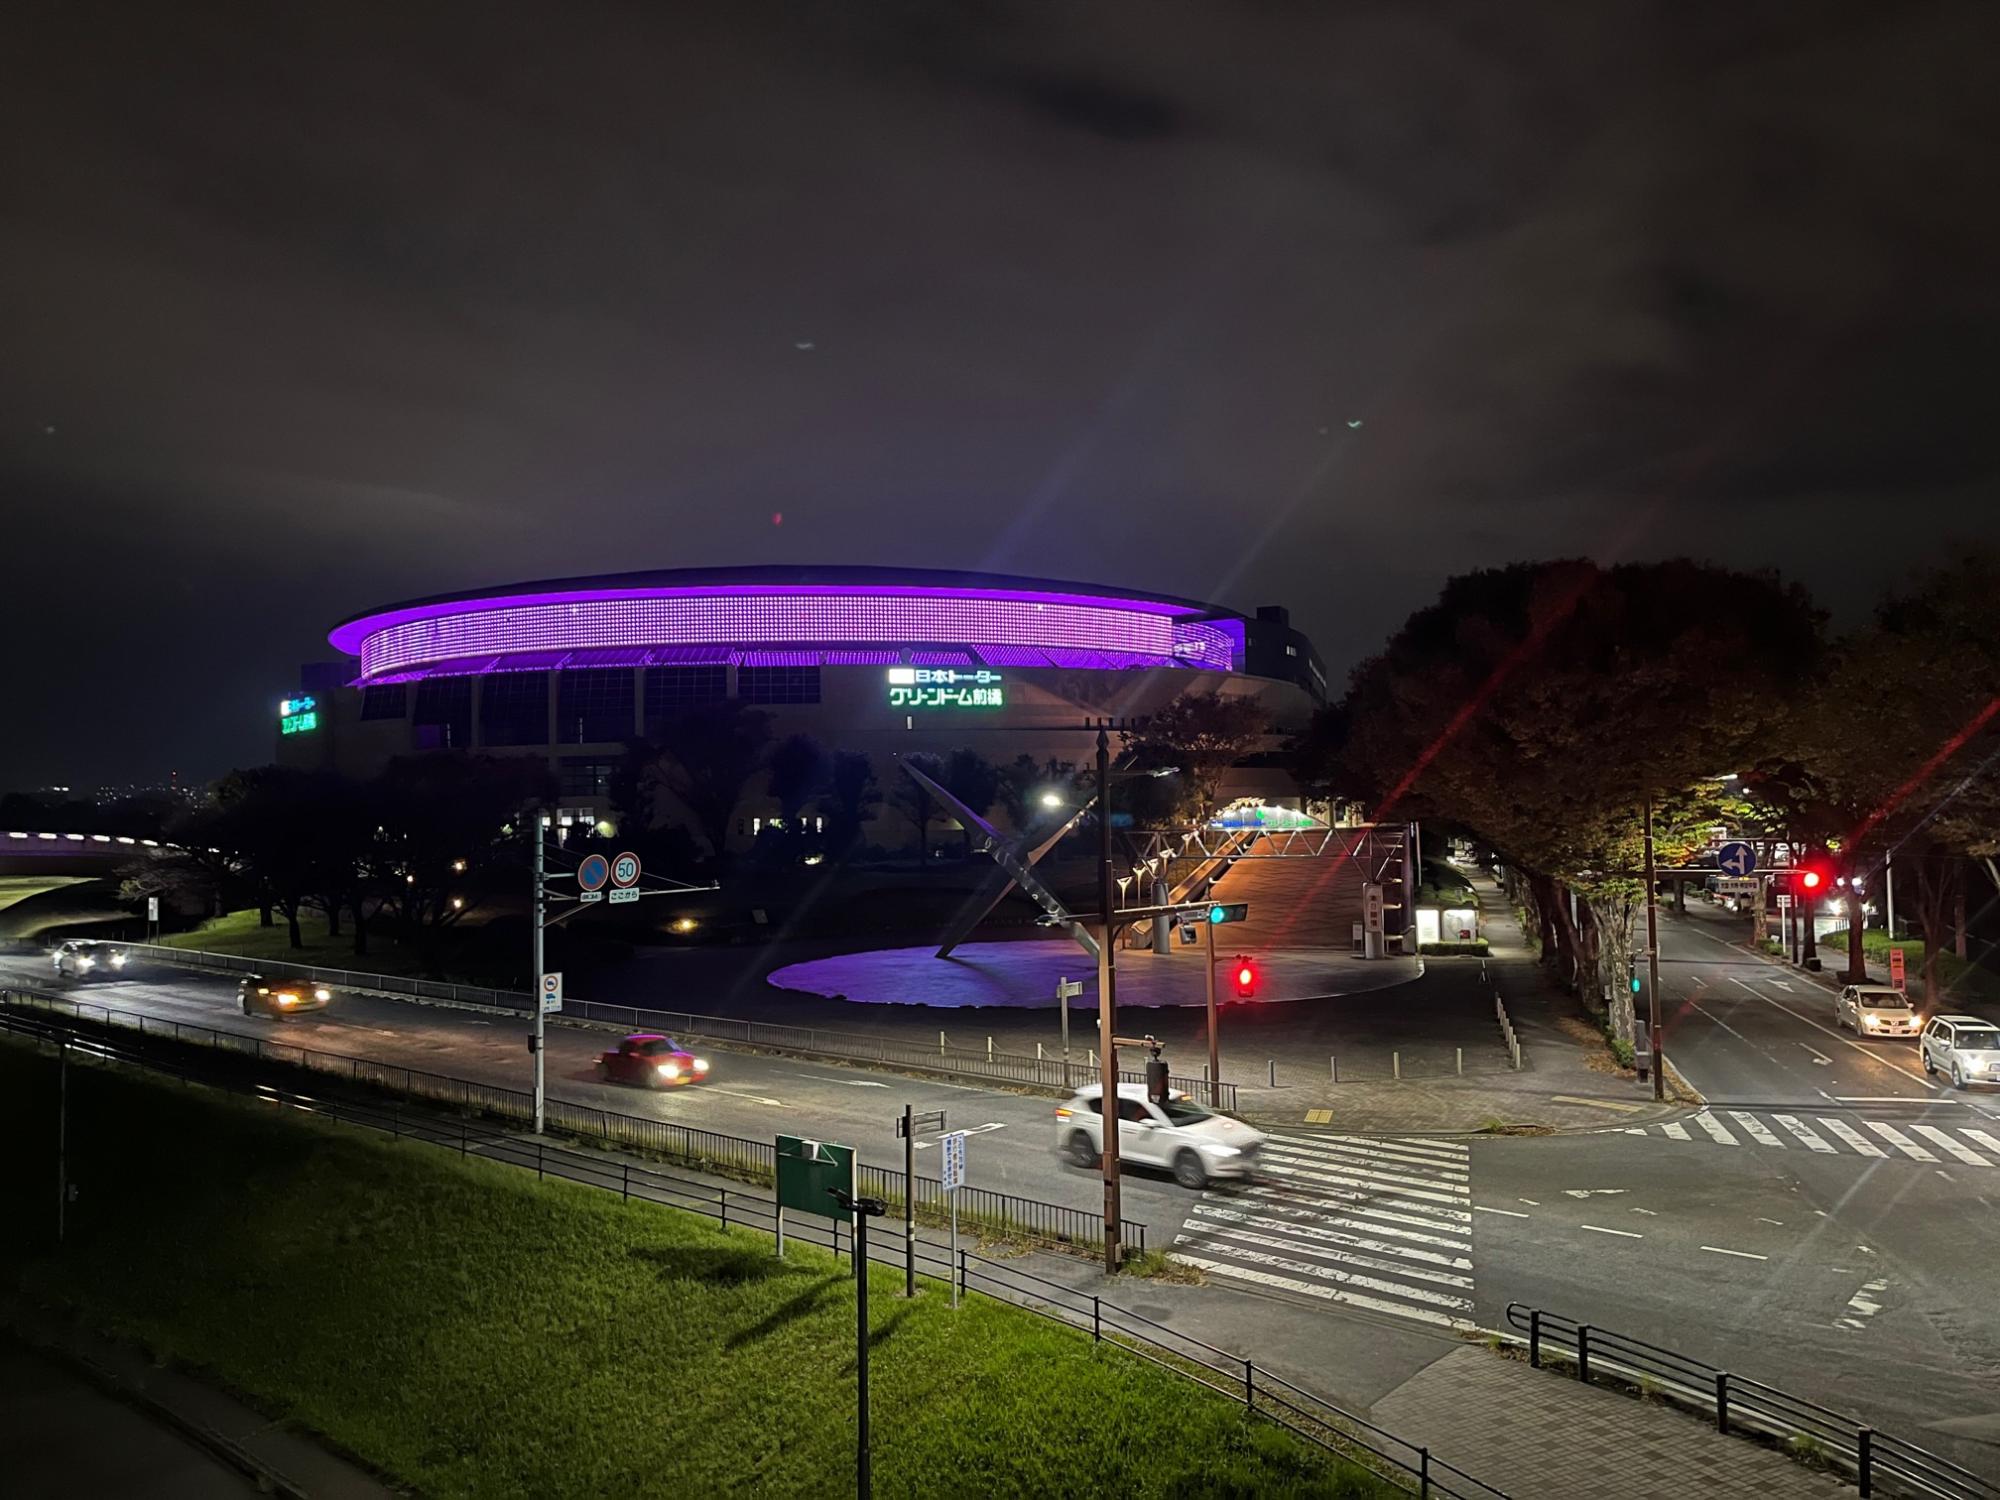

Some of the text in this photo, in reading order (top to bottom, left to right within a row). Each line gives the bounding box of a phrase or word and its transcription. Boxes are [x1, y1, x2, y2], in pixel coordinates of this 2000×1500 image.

[915, 669, 1002, 684] 日本トーター
[618, 862, 634, 878] 50
[611, 890, 638, 900] ここから
